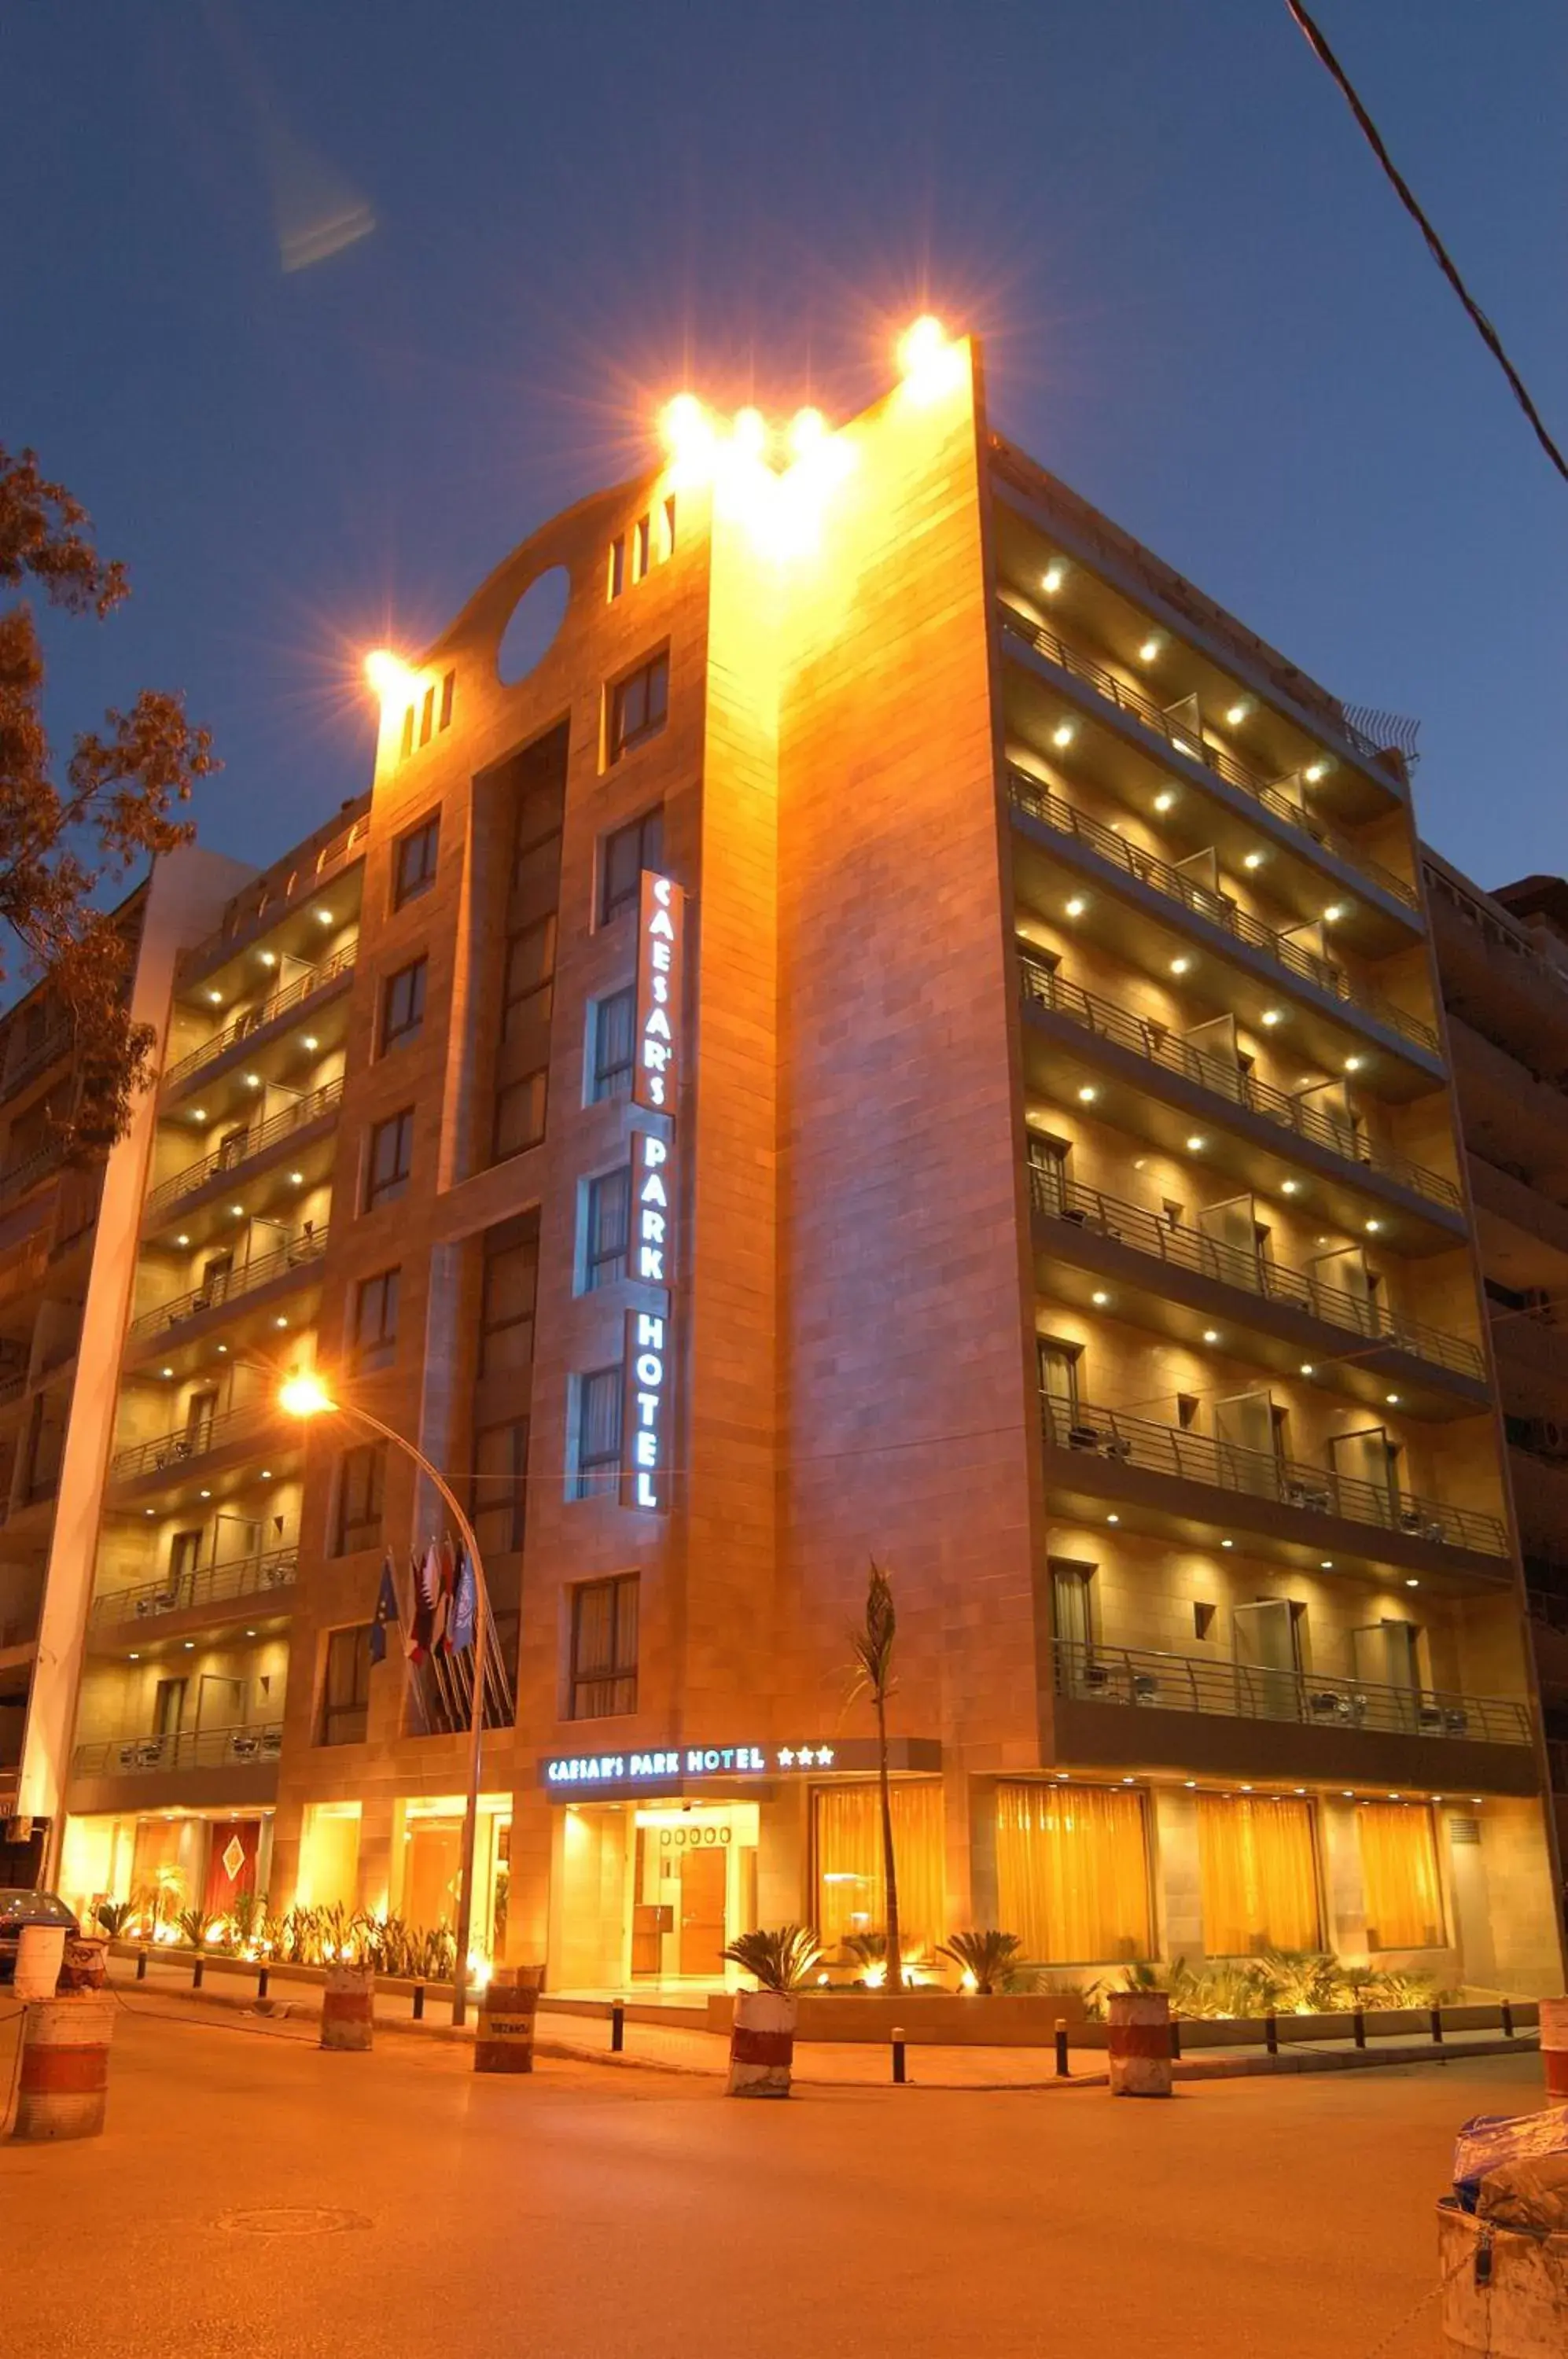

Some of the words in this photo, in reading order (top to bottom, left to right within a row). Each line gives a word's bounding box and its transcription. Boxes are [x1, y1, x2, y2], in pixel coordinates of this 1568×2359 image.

[644, 879, 674, 1105] CAESAR'S
[641, 1136, 667, 1279] PARK
[636, 1313, 663, 1507] HOTEL
[548, 1757, 624, 1781] CAESAR'S
[630, 1753, 679, 1776] PARK
[687, 1747, 764, 1771] HOTEL
